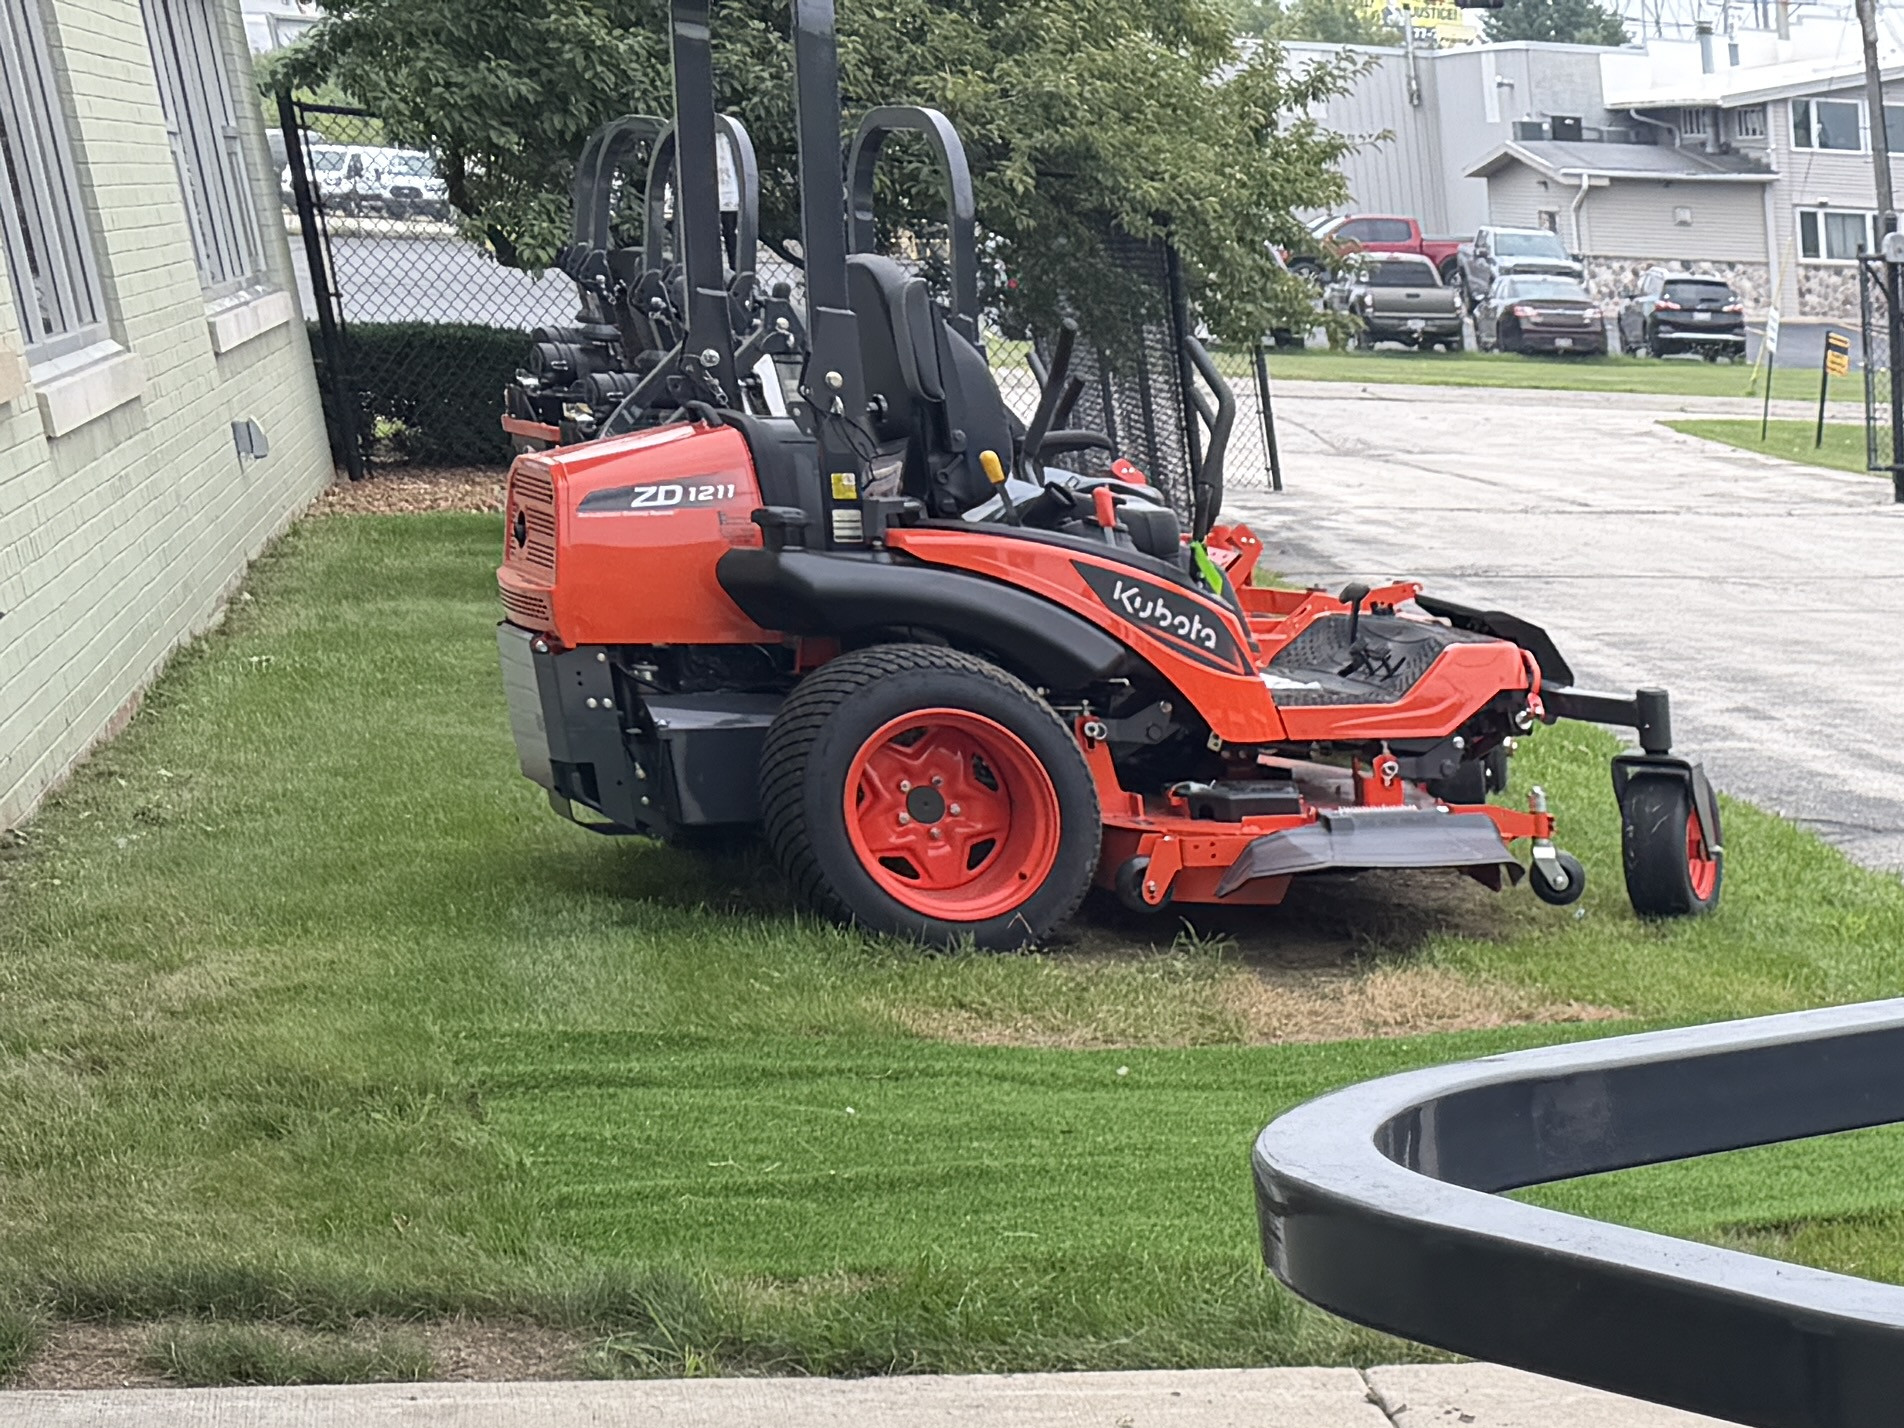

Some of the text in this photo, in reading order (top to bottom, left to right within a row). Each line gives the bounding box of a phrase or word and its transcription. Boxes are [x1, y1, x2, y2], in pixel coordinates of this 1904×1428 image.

[630, 483, 736, 508] ZD 1211
[1113, 580, 1217, 649] Kubota
